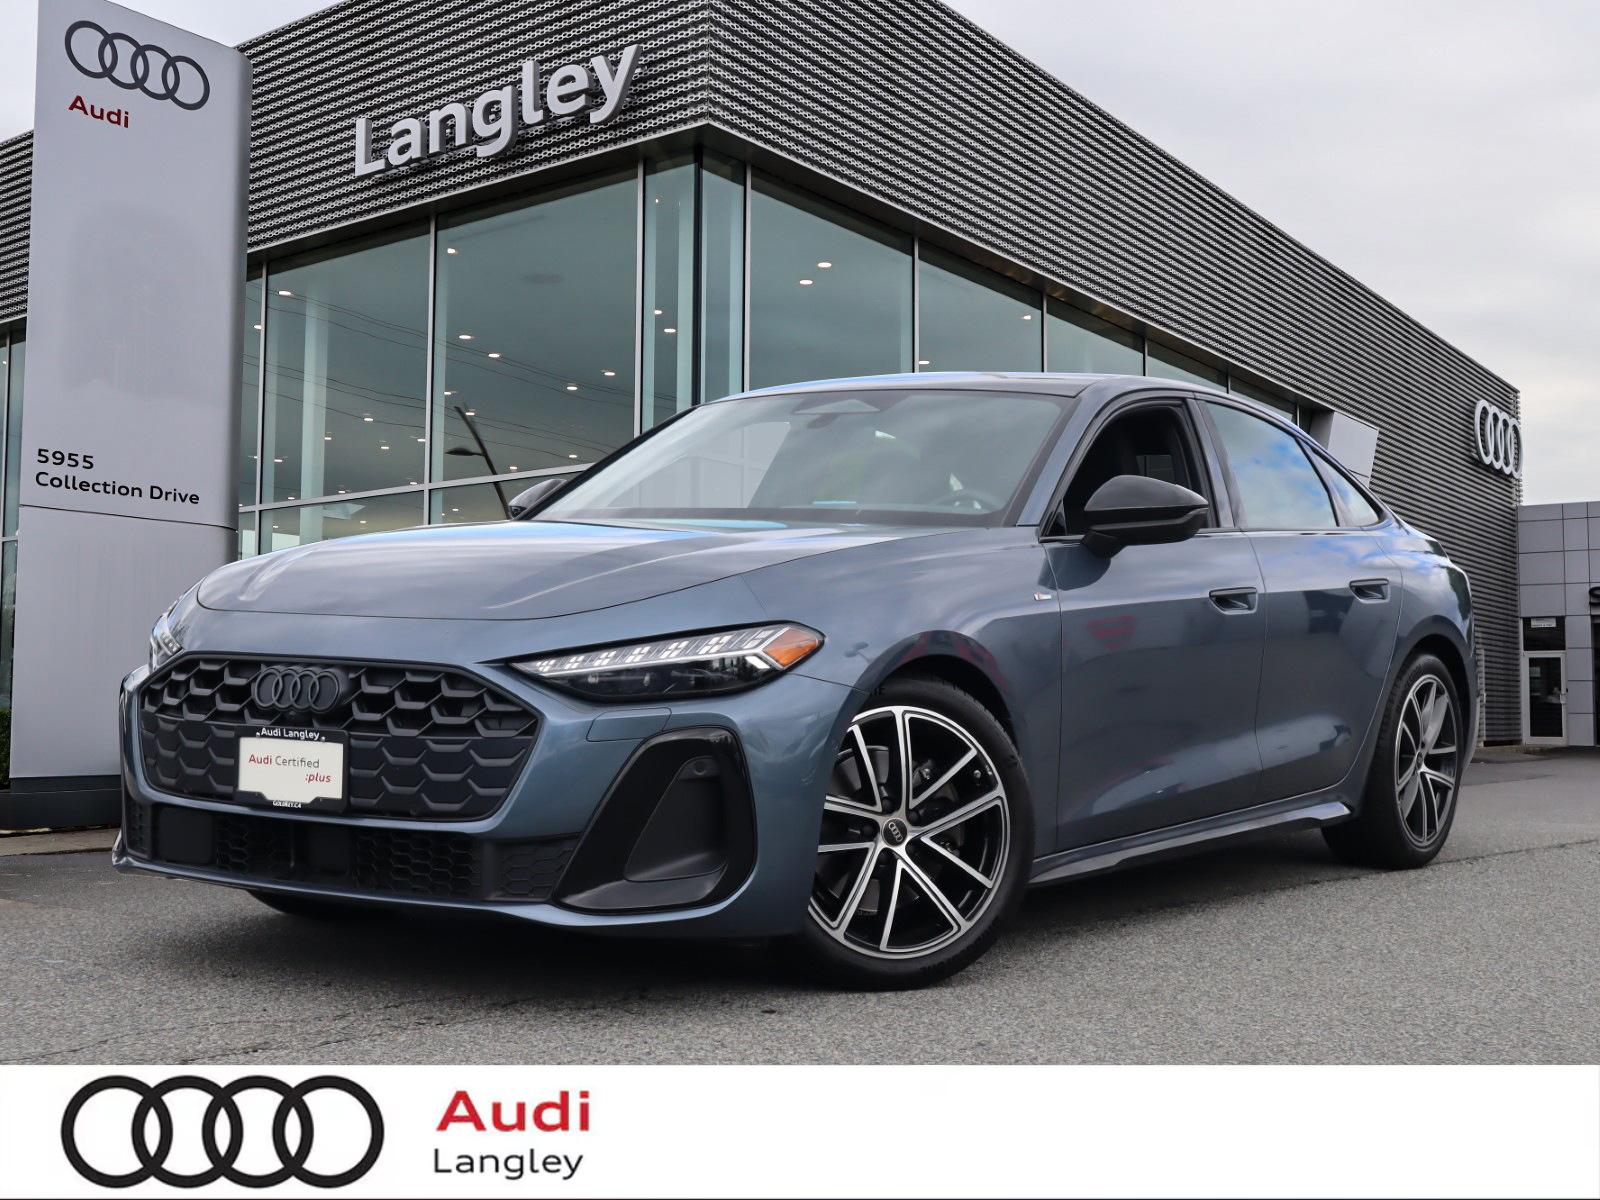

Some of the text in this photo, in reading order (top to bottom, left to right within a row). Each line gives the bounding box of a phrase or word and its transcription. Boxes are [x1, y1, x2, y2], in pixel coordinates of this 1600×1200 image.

[68, 95, 129, 129] Audi
[355, 44, 642, 177] Langley
[36, 448, 95, 470] 5955
[35, 471, 200, 505] Collection Drive
[261, 727, 320, 740] Audi Langley
[248, 754, 320, 769] Audi Certified
[304, 772, 332, 783] :plus
